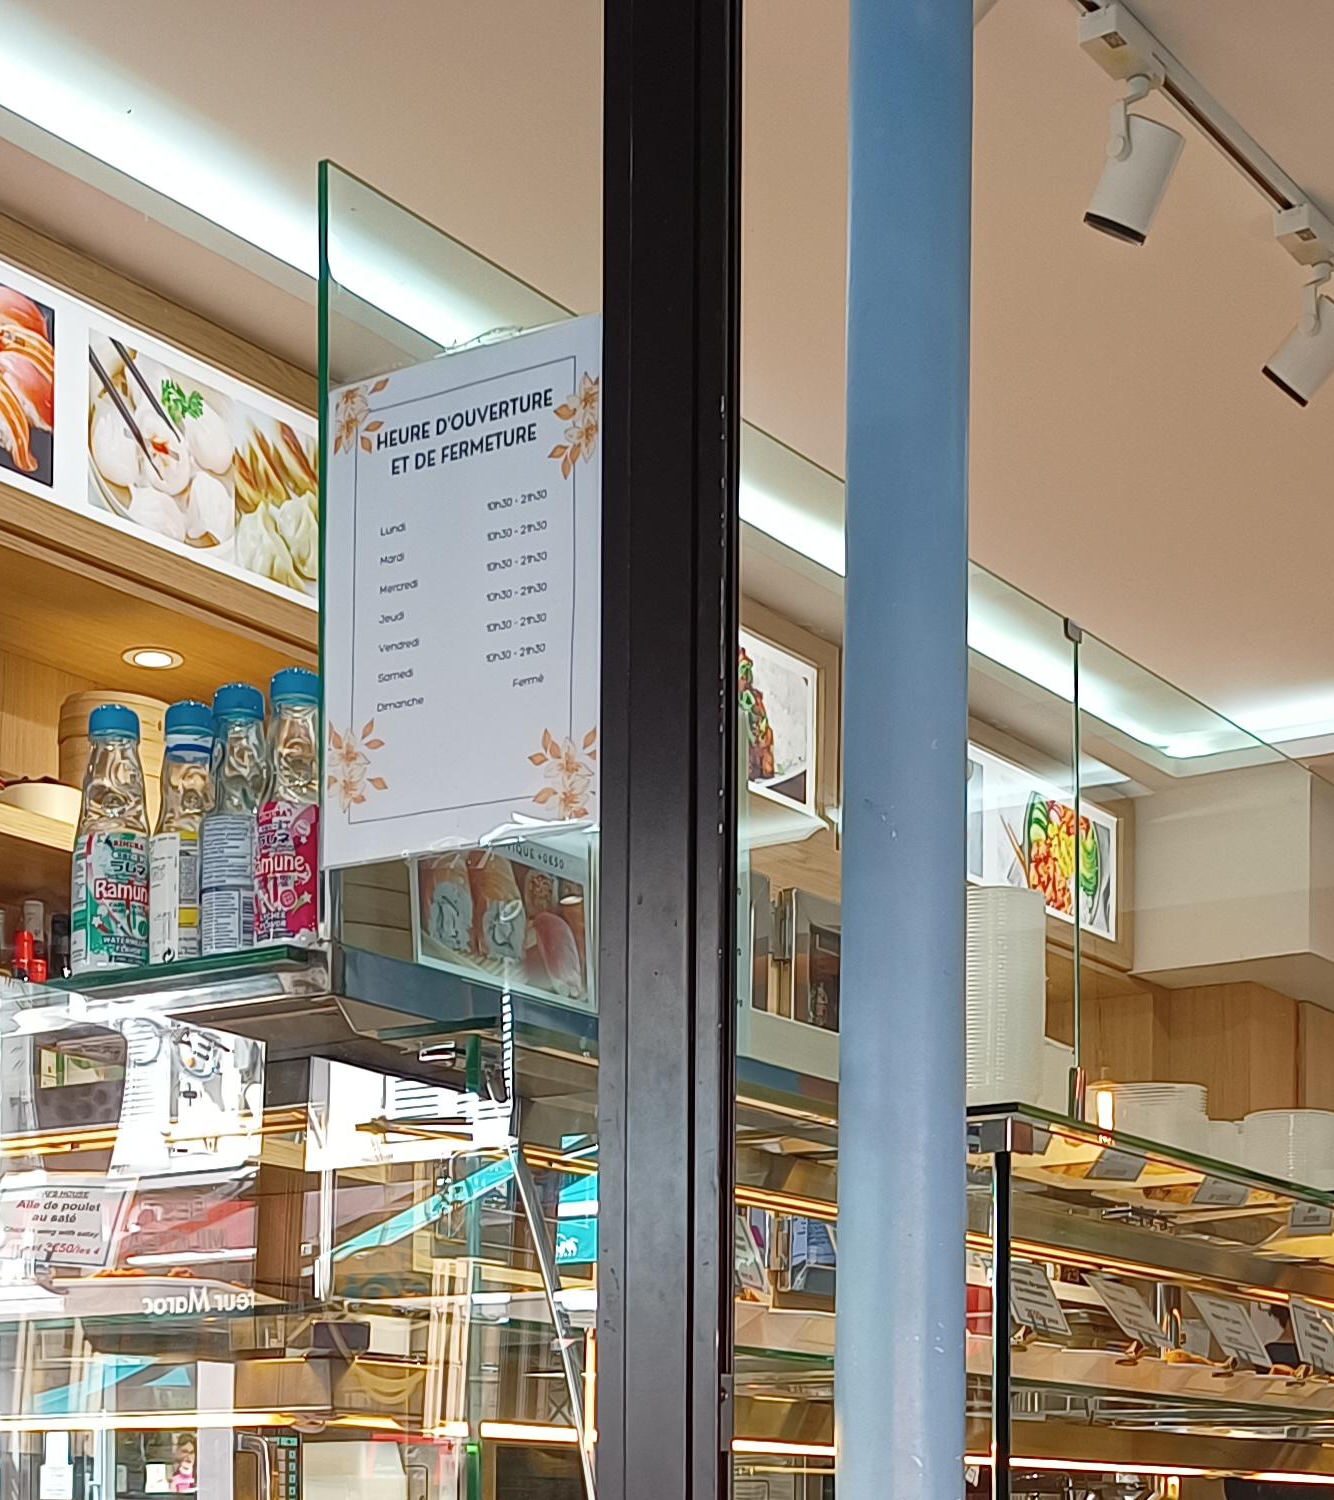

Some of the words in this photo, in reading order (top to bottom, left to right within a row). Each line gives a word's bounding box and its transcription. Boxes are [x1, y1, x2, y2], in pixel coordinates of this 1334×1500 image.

[376, 421, 430, 450] HEURE
[436, 388, 553, 436] D'OUVERTURE
[391, 456, 410, 475] ET
[415, 449, 436, 470] DE
[441, 422, 537, 464] FERMETURE
[380, 522, 406, 536] Lundi
[380, 552, 405, 565] Mardi
[379, 579, 418, 594] Mercredi
[379, 611, 404, 624] Jeudi
[378, 638, 419, 652] Vendredi
[378, 668, 413, 683] Samedi
[512, 673, 544, 688] Fermé
[377, 697, 424, 712] Dimanche
[254, 854, 305, 875] amune
[94, 879, 148, 903] Ramun
[16, 1199, 40, 1209] Aile
[43, 1201, 59, 1209] de
[61, 1202, 101, 1212] poulet
[31, 1213, 47, 1222] au
